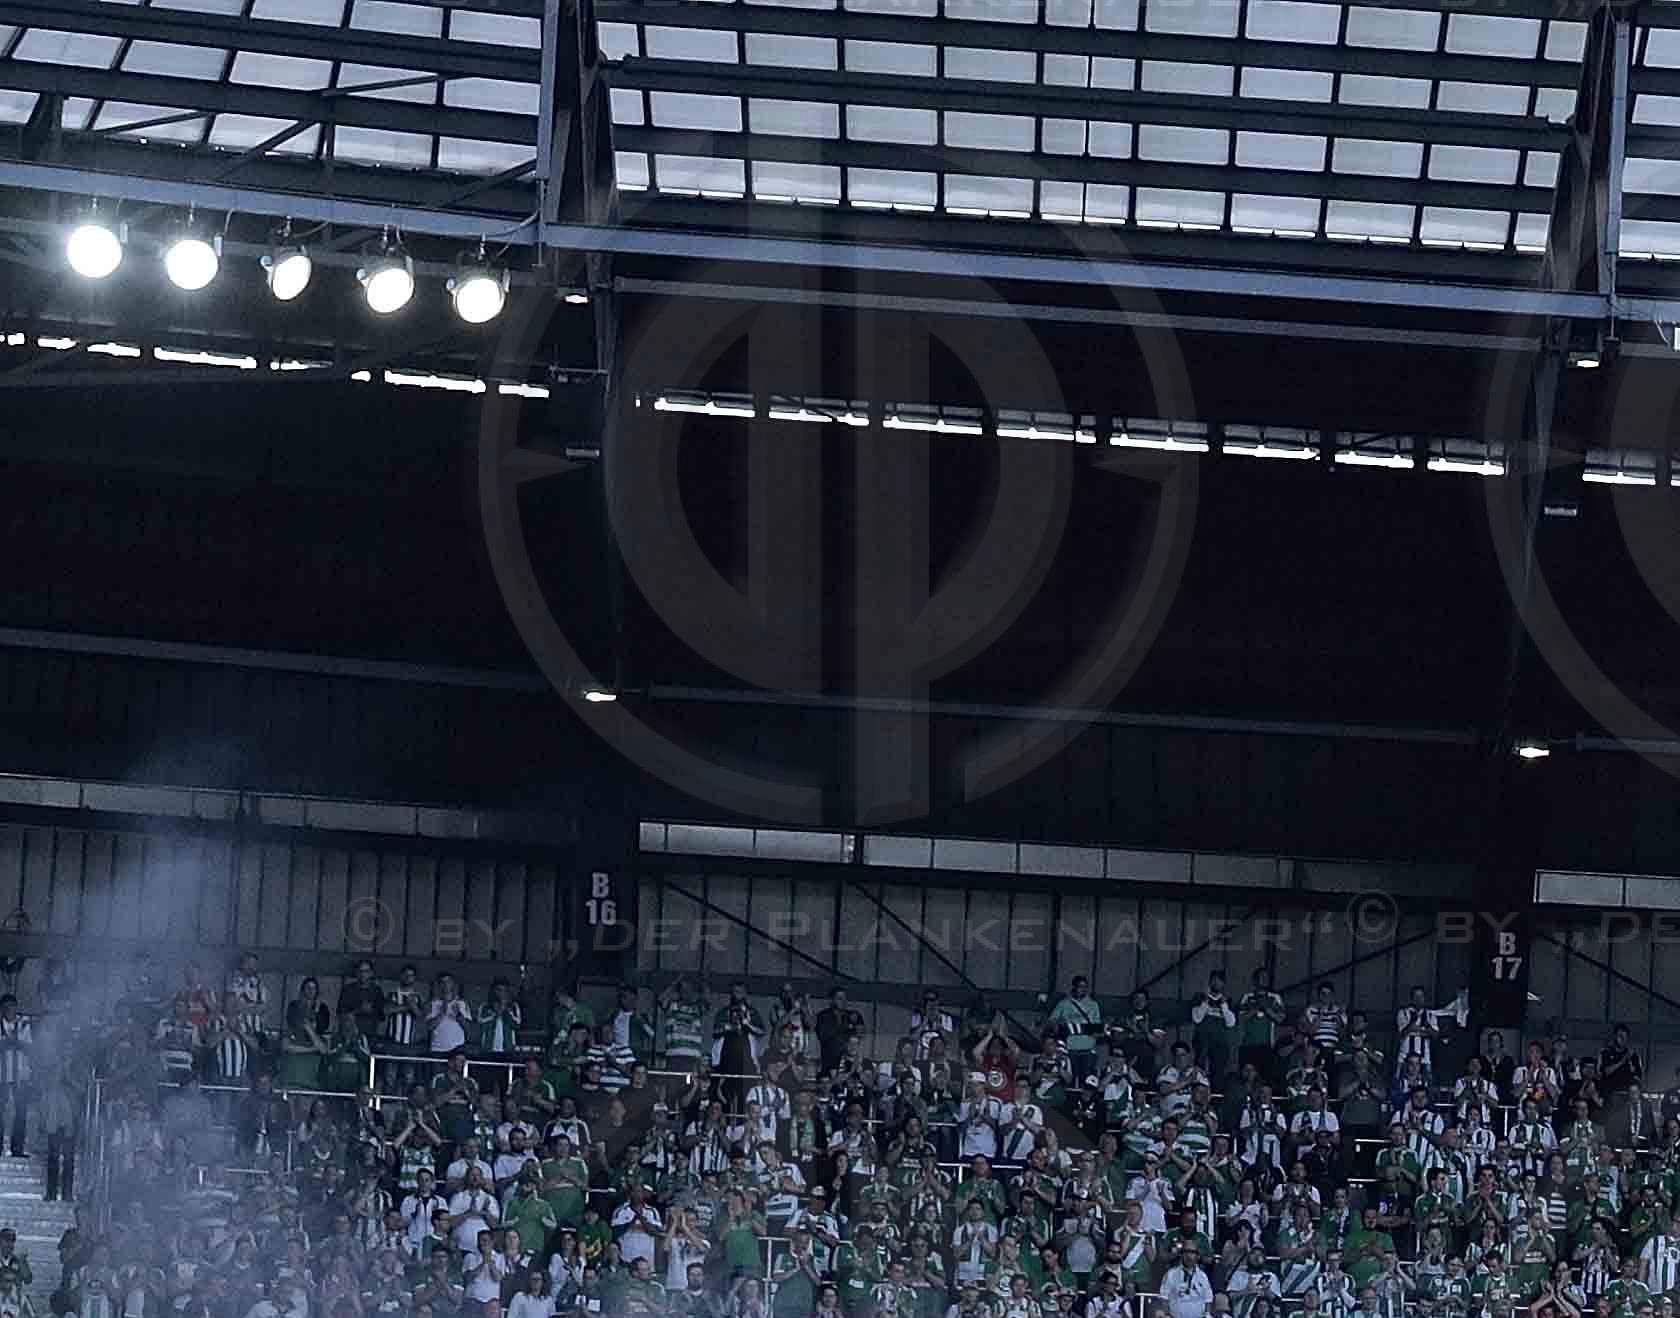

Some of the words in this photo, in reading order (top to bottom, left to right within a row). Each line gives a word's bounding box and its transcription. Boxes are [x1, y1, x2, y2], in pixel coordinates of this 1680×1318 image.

[592, 872, 609, 898] B
[585, 901, 617, 926] 16
[1498, 931, 1515, 957] B
[1491, 957, 1521, 982] 17
